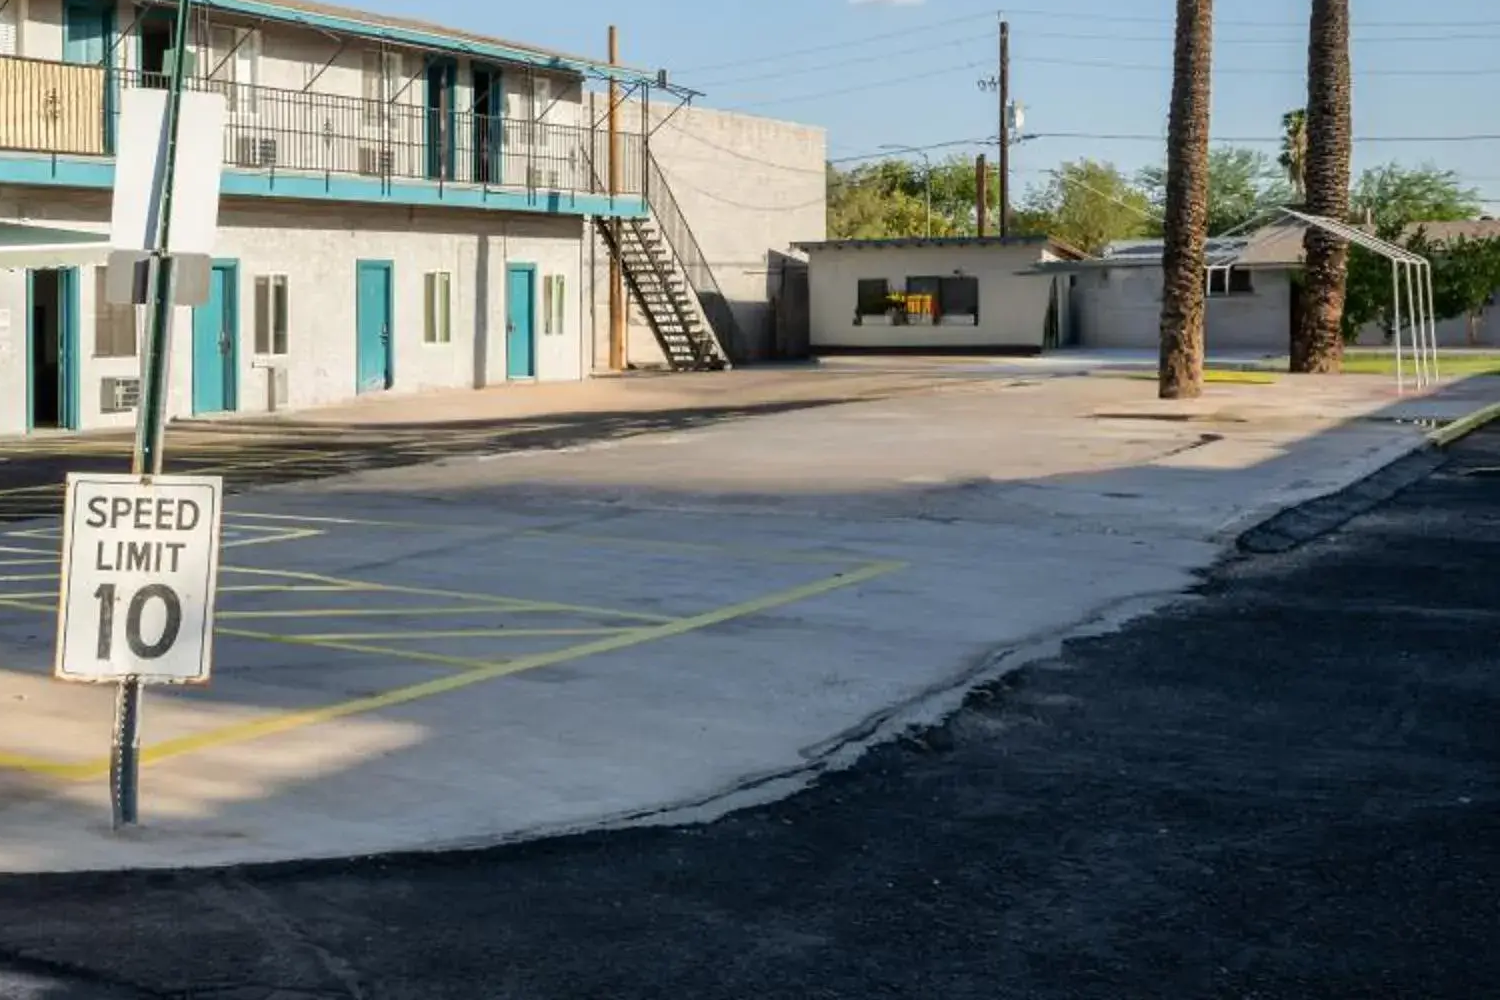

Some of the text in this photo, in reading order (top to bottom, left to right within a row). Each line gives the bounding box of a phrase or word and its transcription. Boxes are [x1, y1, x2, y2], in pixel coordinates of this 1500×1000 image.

[86, 496, 200, 531] SPEED
[96, 541, 186, 572] LIMIT
[94, 583, 182, 660] 10
